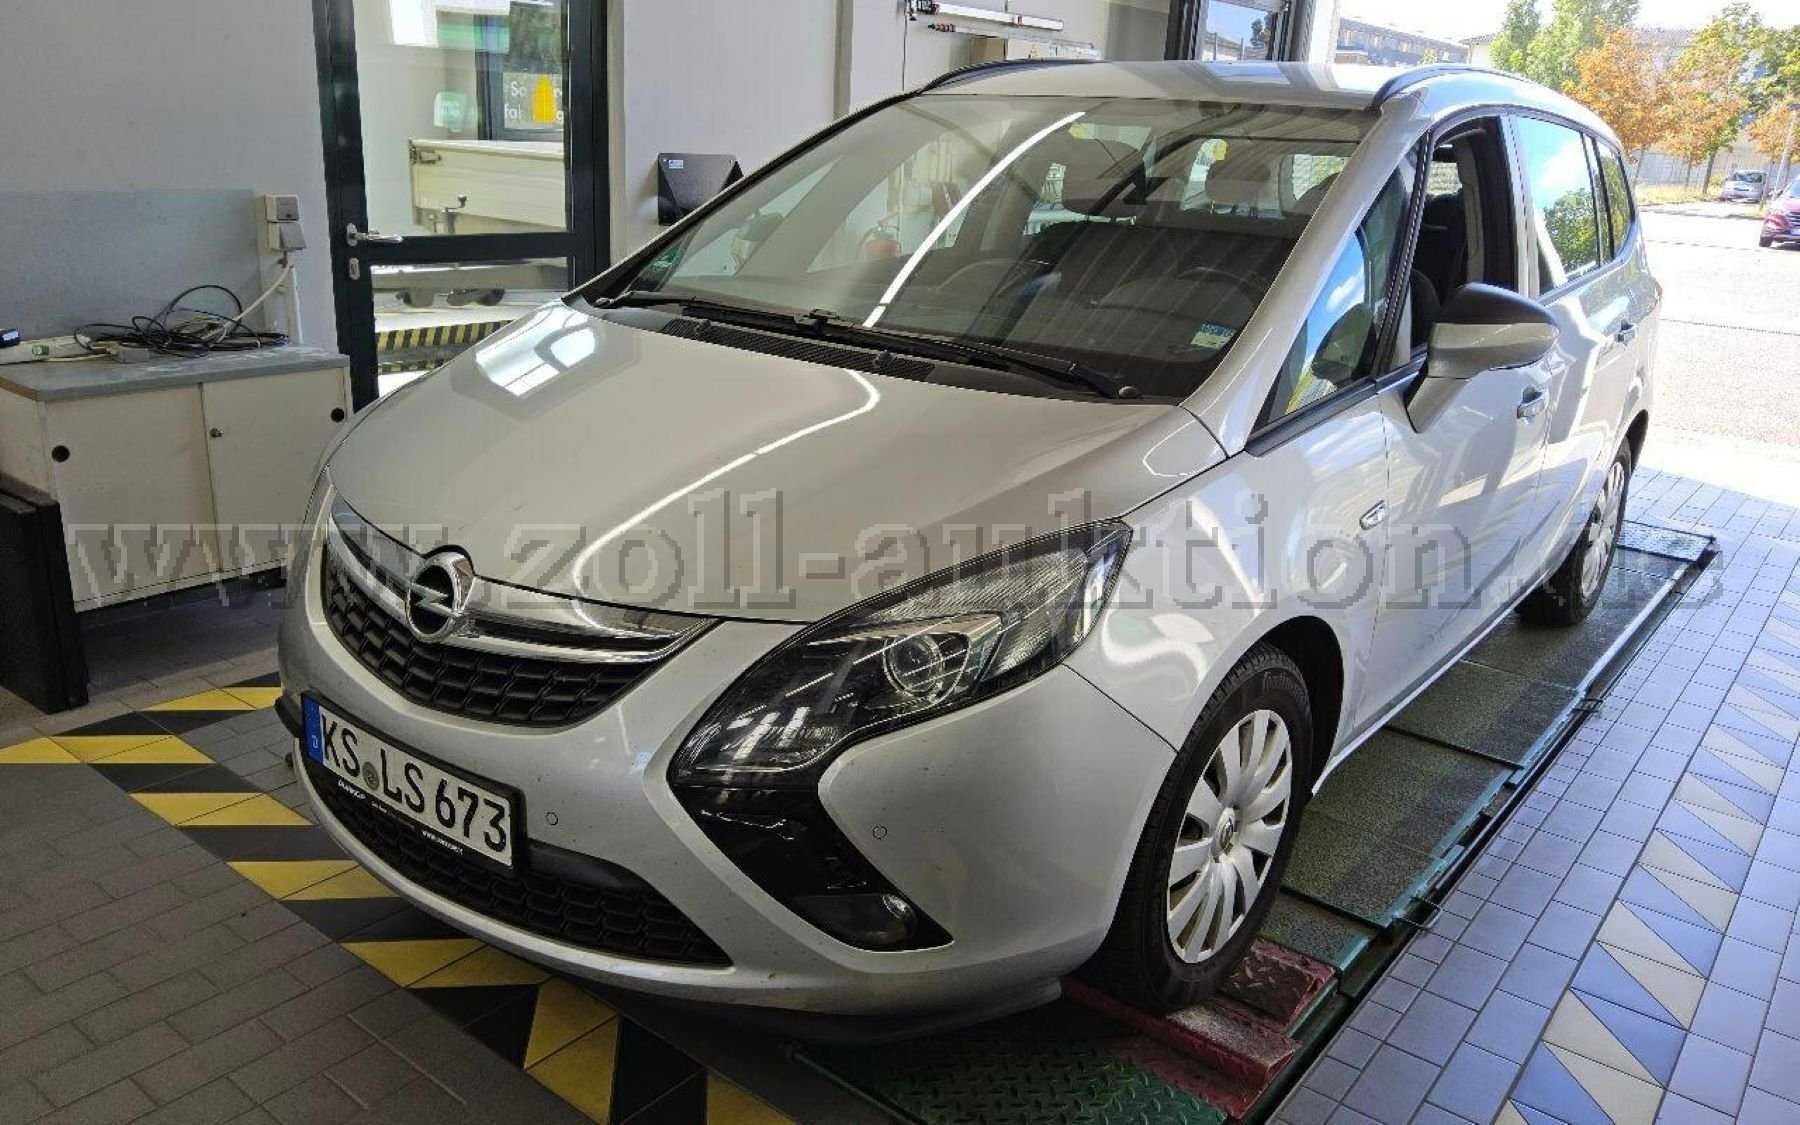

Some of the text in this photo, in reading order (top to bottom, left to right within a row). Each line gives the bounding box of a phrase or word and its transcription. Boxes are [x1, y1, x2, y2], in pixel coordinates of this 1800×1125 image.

[322, 713, 361, 778] KS
[380, 748, 425, 814] LS
[435, 777, 507, 852] 673
